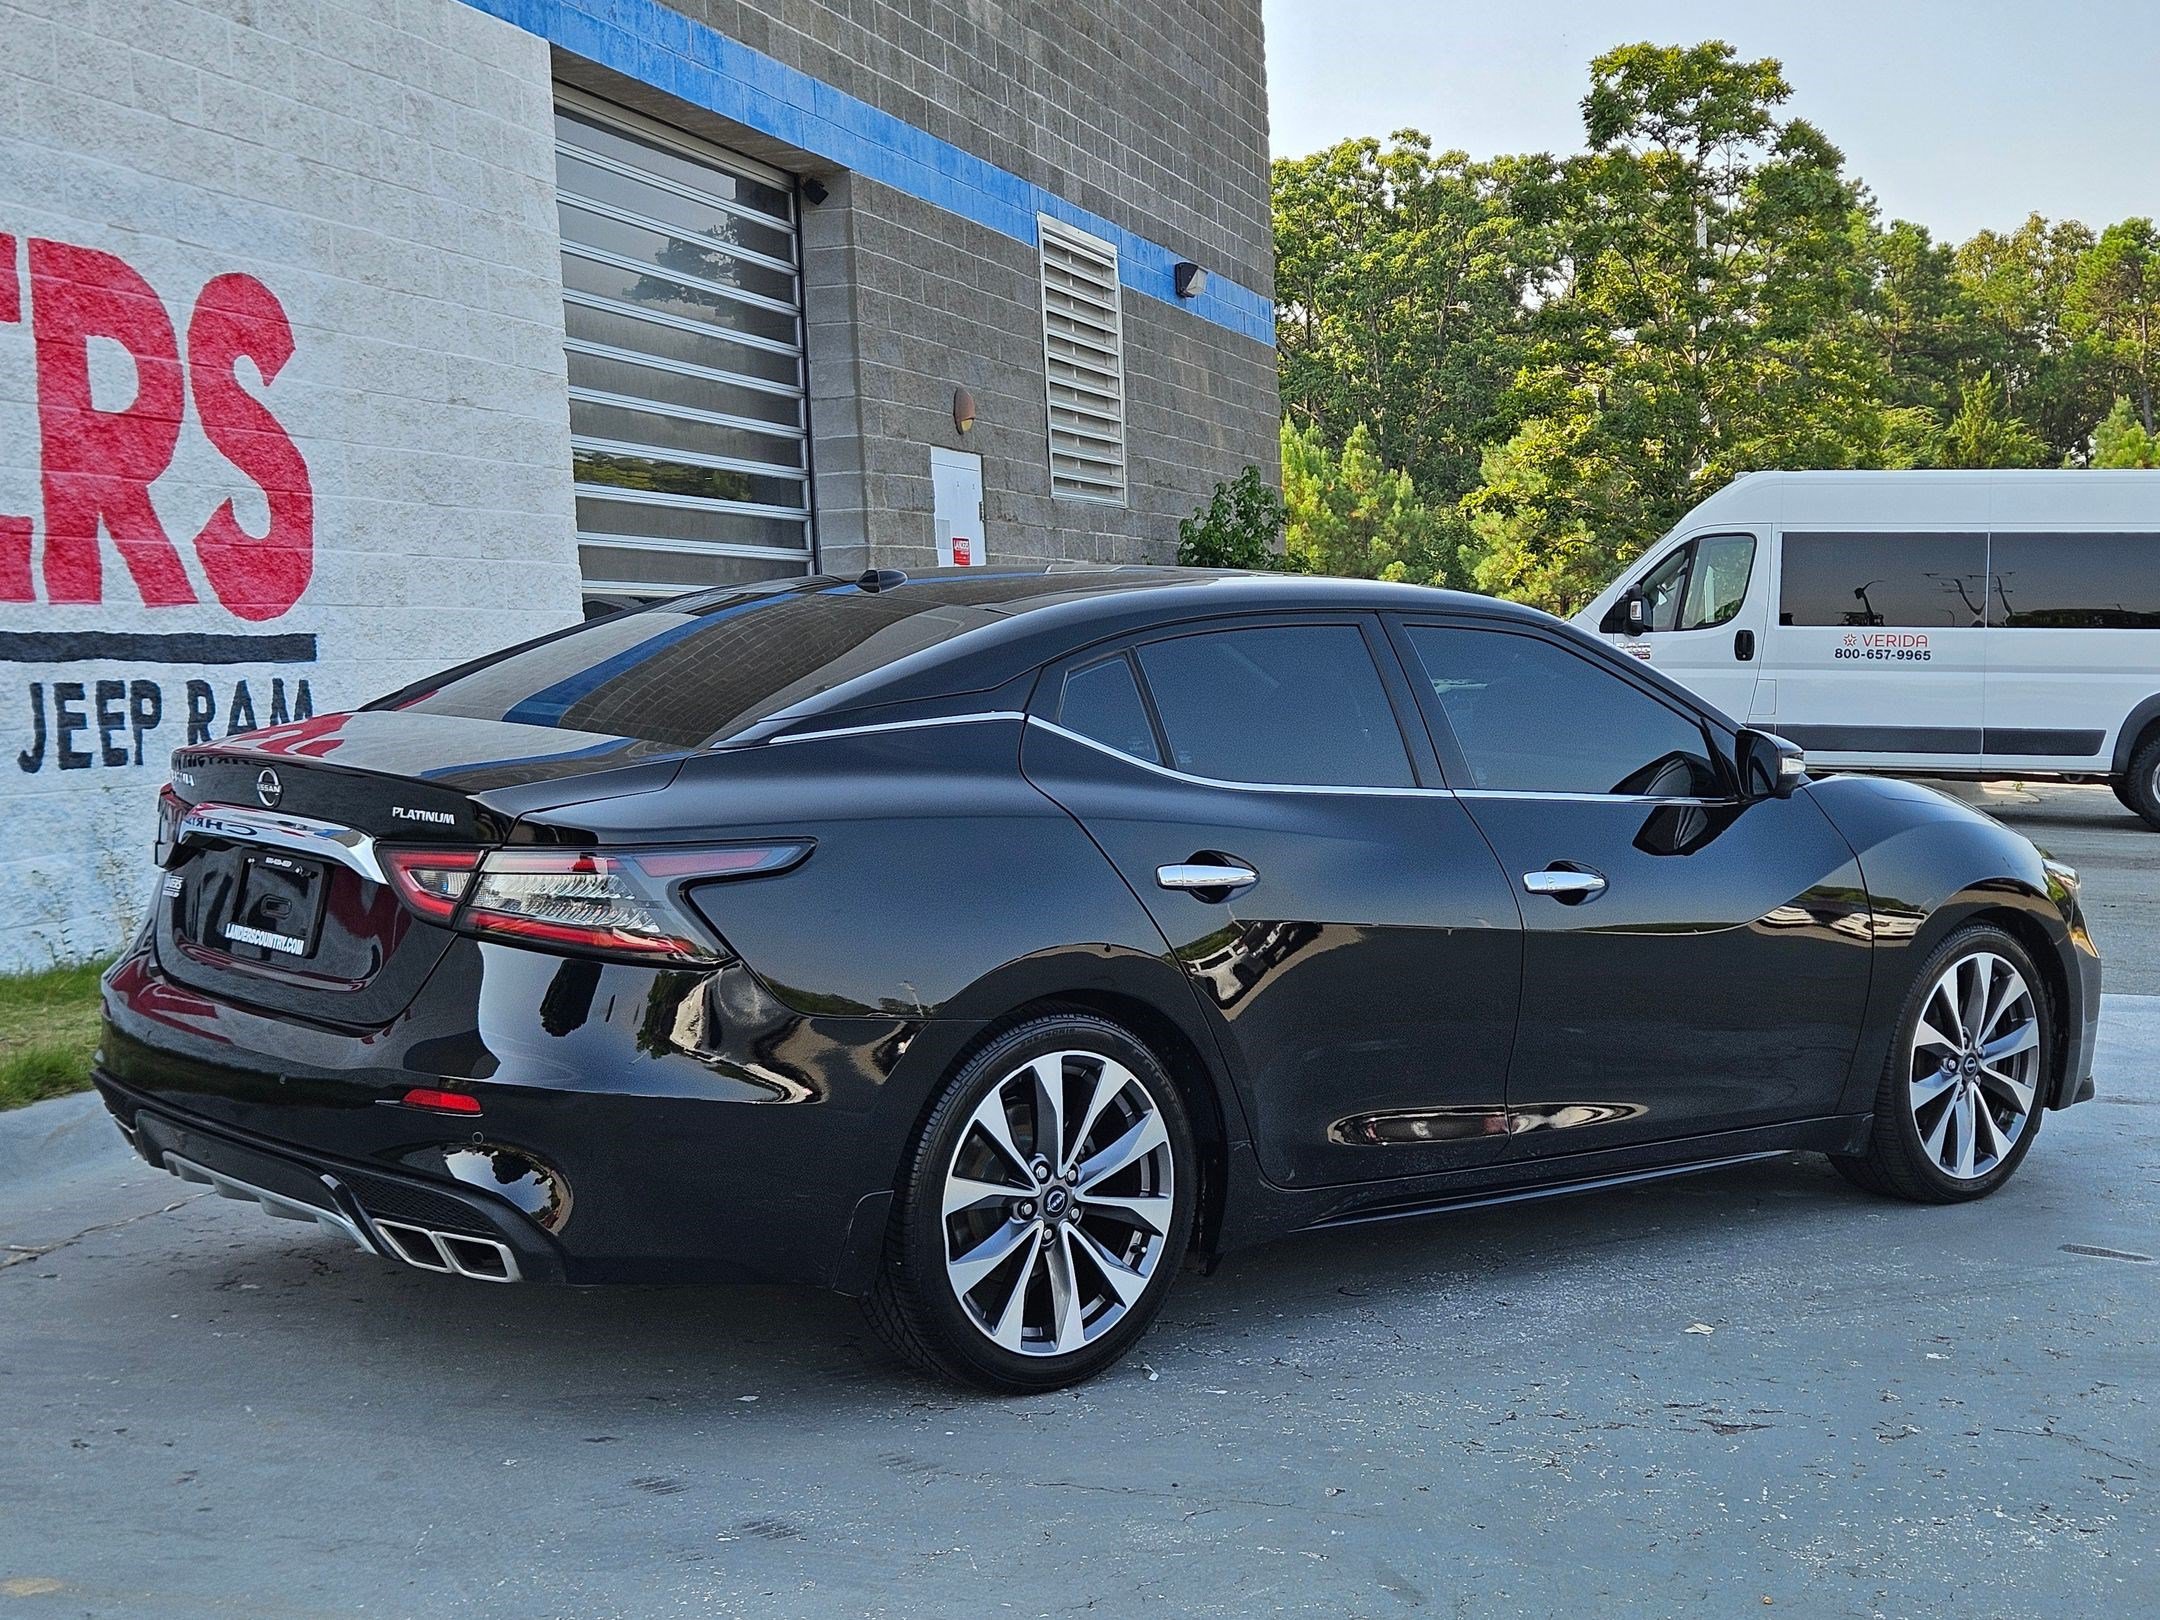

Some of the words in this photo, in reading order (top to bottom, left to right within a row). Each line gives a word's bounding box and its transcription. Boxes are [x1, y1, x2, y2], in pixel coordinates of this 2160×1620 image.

[0, 232, 313, 621] RS
[1862, 634, 1928, 648] VERIDA
[1834, 648, 1931, 661] 800-657-9965
[17, 679, 162, 773] JEEP
[392, 806, 455, 825] PLATINUM
[225, 923, 305, 955] LANDERSCOUNTRY.COM
